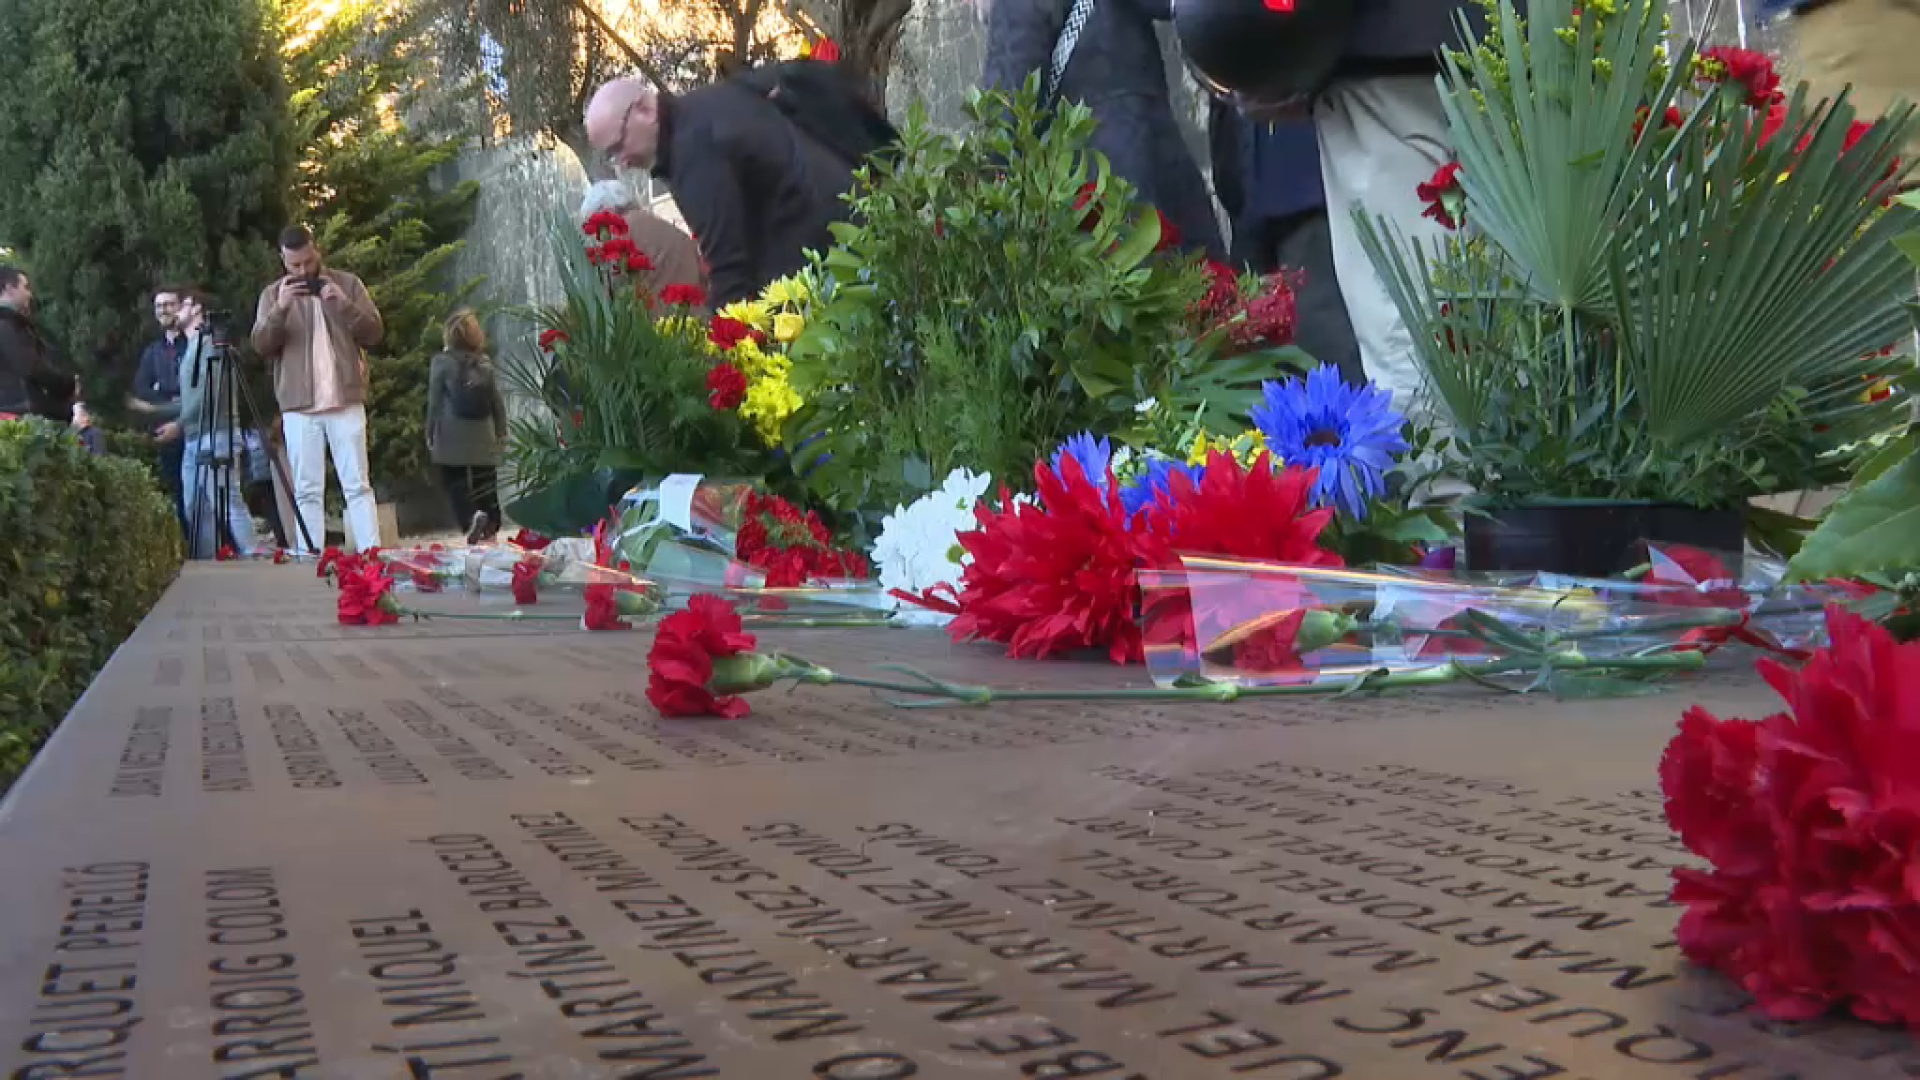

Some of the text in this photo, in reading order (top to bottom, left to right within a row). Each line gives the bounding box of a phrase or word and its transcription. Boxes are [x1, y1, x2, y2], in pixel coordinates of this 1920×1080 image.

[510, 811, 663, 893] MARTÍNEZ
[1232, 829, 1636, 932] MARTORELL
[1342, 823, 1682, 908] ARTORELL
[1382, 804, 1692, 878] ARTORELL
[205, 867, 288, 946] COLOM
[408, 833, 722, 1080] MARTÍNEZ BARCELÓ
[618, 813, 1147, 1080] BÉ MARTÍNEZ SÁNCHEZ
[858, 878, 1177, 1009] MARTÍNEZ
[997, 878, 1354, 1006] MARTÍNEZ
[1060, 849, 1441, 973] MARTORELL
[1230, 861, 1680, 991] MARTORELL
[8, 861, 151, 1080] RQUET PERELLÓ
[348, 908, 486, 1027] MIQUEL
[611, 894, 867, 1043] MARTÍNEZ
[371, 1036, 524, 1080] TÍ
[1332, 1006, 1568, 1080] ENÇ
